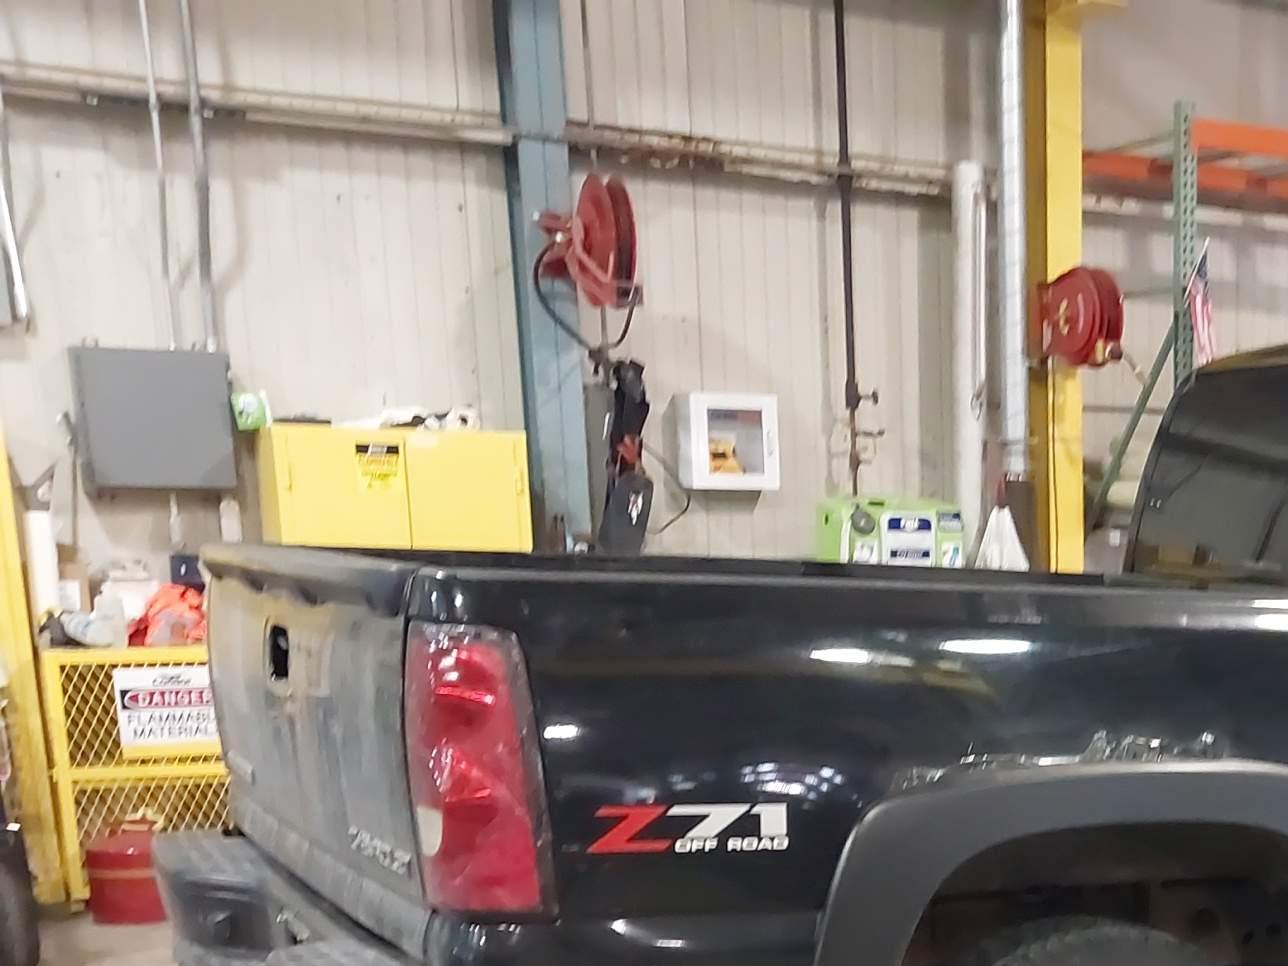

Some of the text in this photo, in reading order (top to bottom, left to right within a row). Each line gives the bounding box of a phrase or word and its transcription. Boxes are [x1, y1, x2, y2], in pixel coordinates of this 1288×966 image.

[128, 711, 214, 726] FLAMMABL
[587, 803, 788, 853] Z71
[675, 837, 789, 853] OFF ROAD
